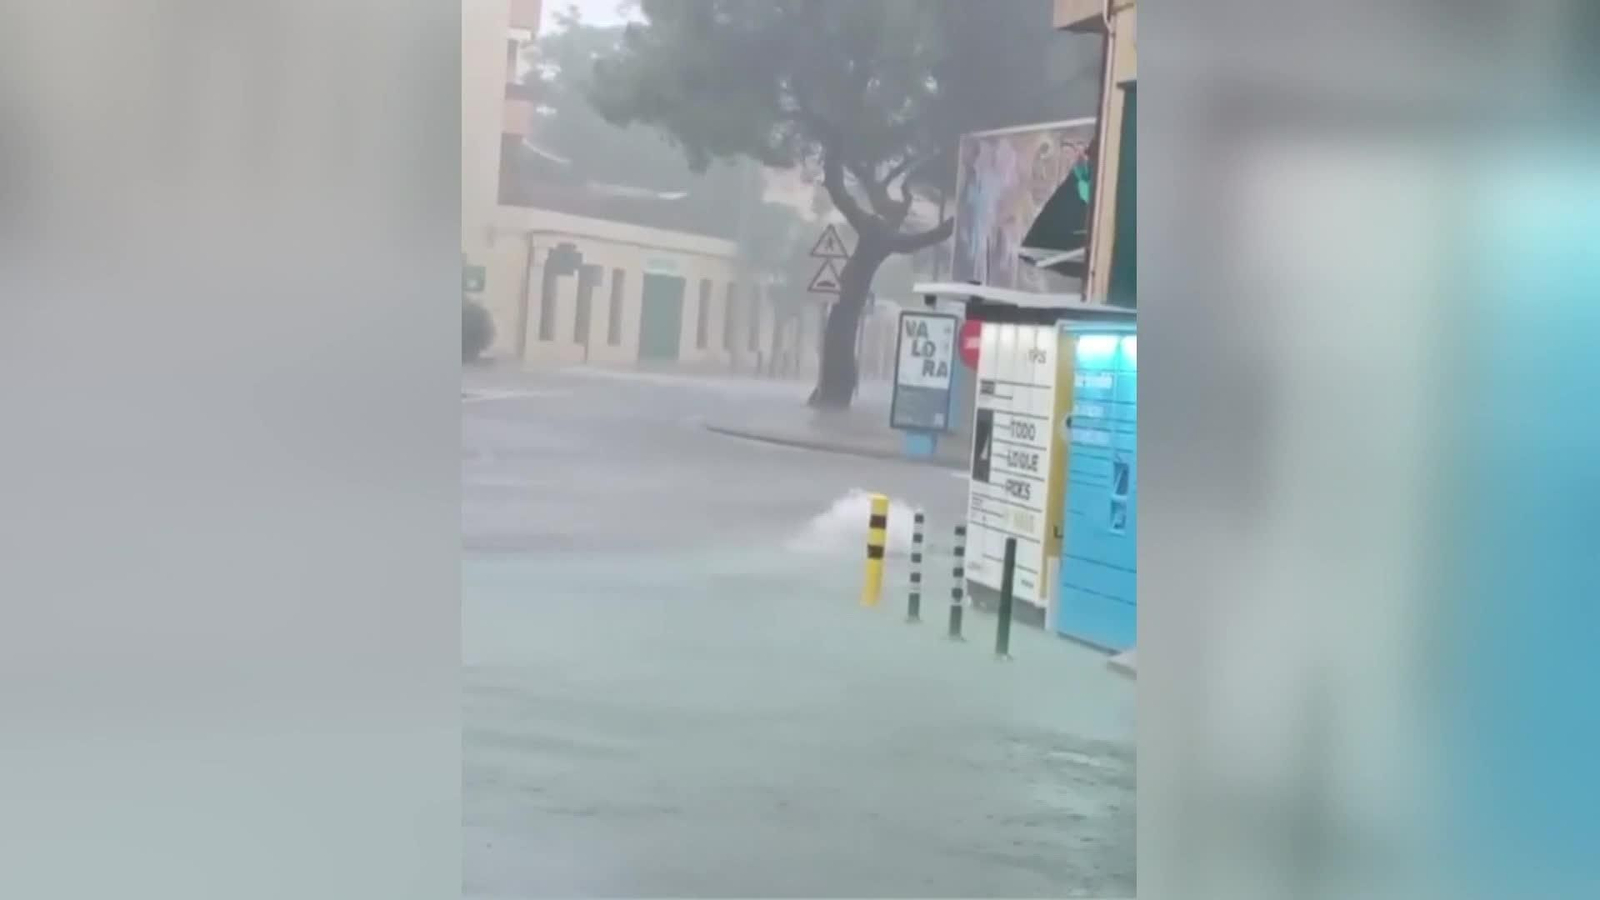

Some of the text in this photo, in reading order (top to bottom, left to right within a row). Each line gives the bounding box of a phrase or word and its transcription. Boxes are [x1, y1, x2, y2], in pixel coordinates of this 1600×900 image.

[905, 319, 928, 338] VA
[911, 340, 936, 358] LO
[922, 359, 948, 378] RA
